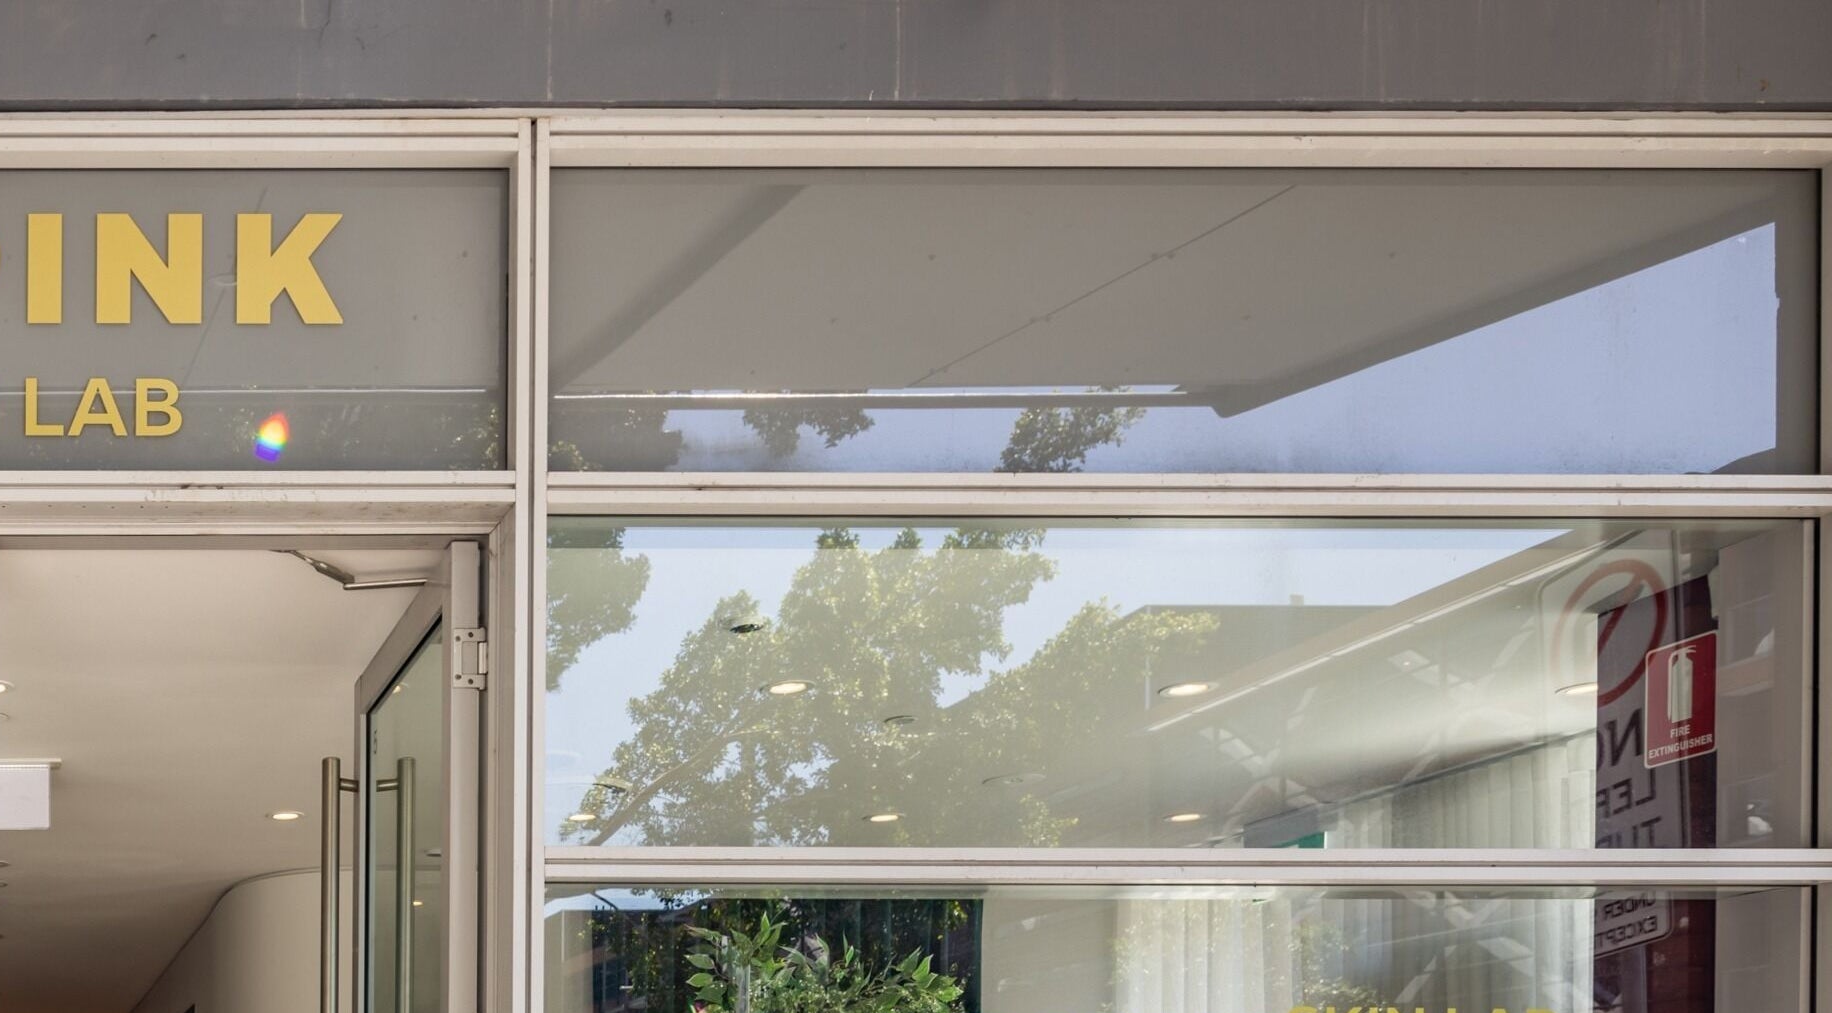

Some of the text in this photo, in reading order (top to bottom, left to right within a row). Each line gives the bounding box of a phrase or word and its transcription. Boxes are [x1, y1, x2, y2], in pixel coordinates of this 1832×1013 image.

[25, 376, 184, 437] LAB
[1670, 725, 1691, 739] FIRE
[1648, 733, 1713, 759] EXTINGUISHER
